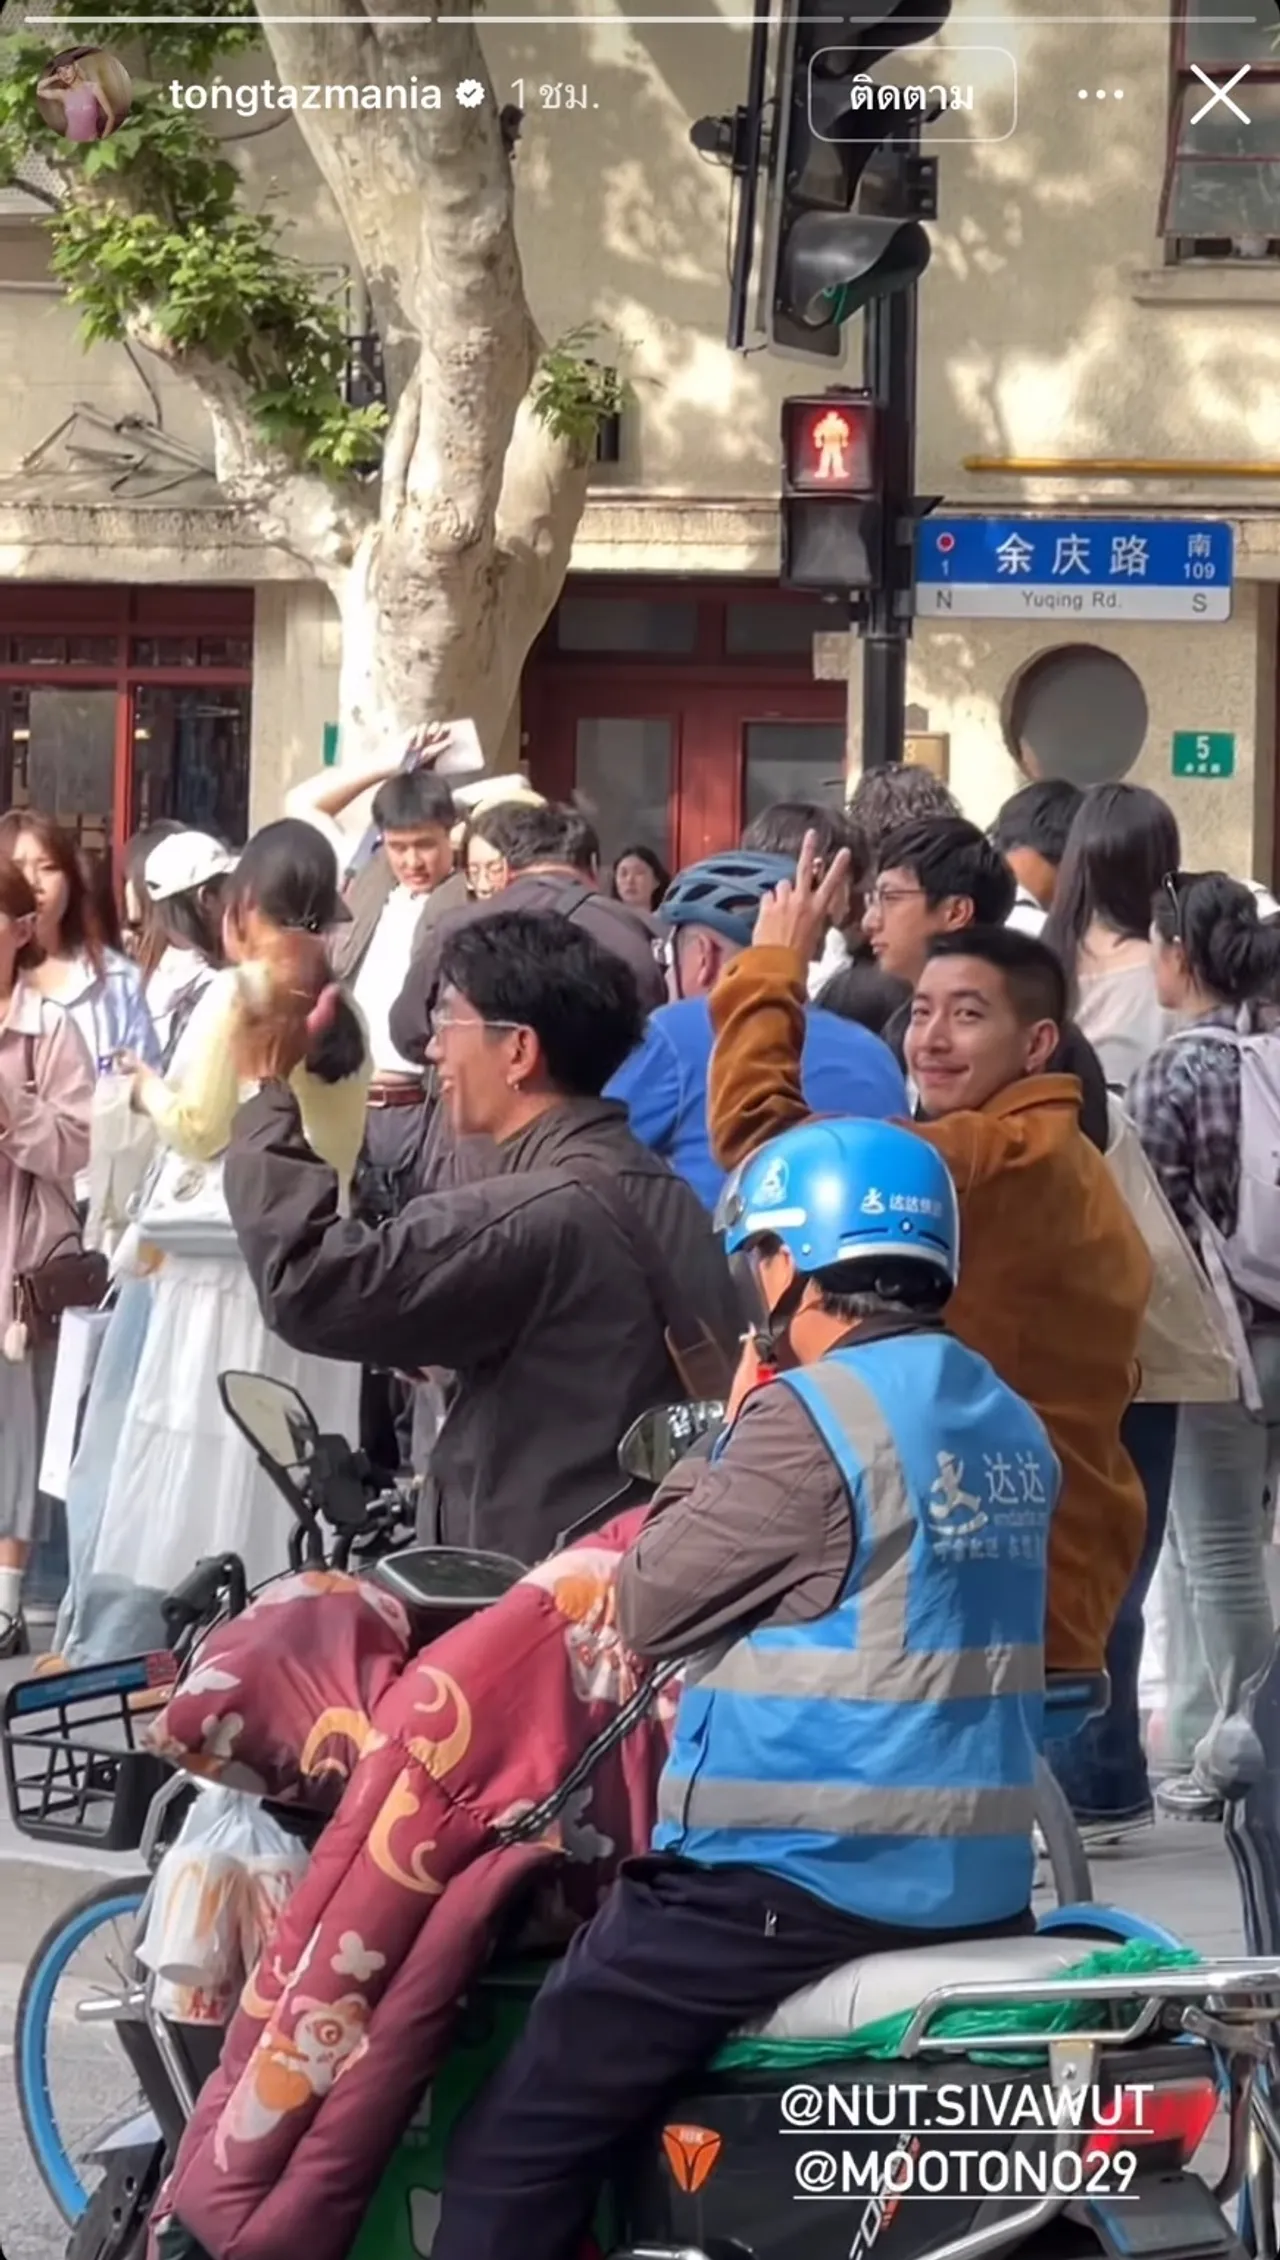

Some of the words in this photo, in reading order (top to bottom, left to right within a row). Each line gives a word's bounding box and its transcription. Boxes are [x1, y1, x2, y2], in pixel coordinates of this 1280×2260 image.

[996, 532, 1150, 577] 余庆路
[1187, 533, 1212, 558] 南
[941, 559, 949, 576] 1
[1184, 563, 1216, 580] 109
[936, 589, 953, 609] N
[1022, 590, 1083, 611] Yuqing
[1091, 591, 1122, 609] Rd.
[1191, 593, 1208, 614] S
[1196, 735, 1210, 761] 5
[982, 1451, 1047, 1504] 达达
